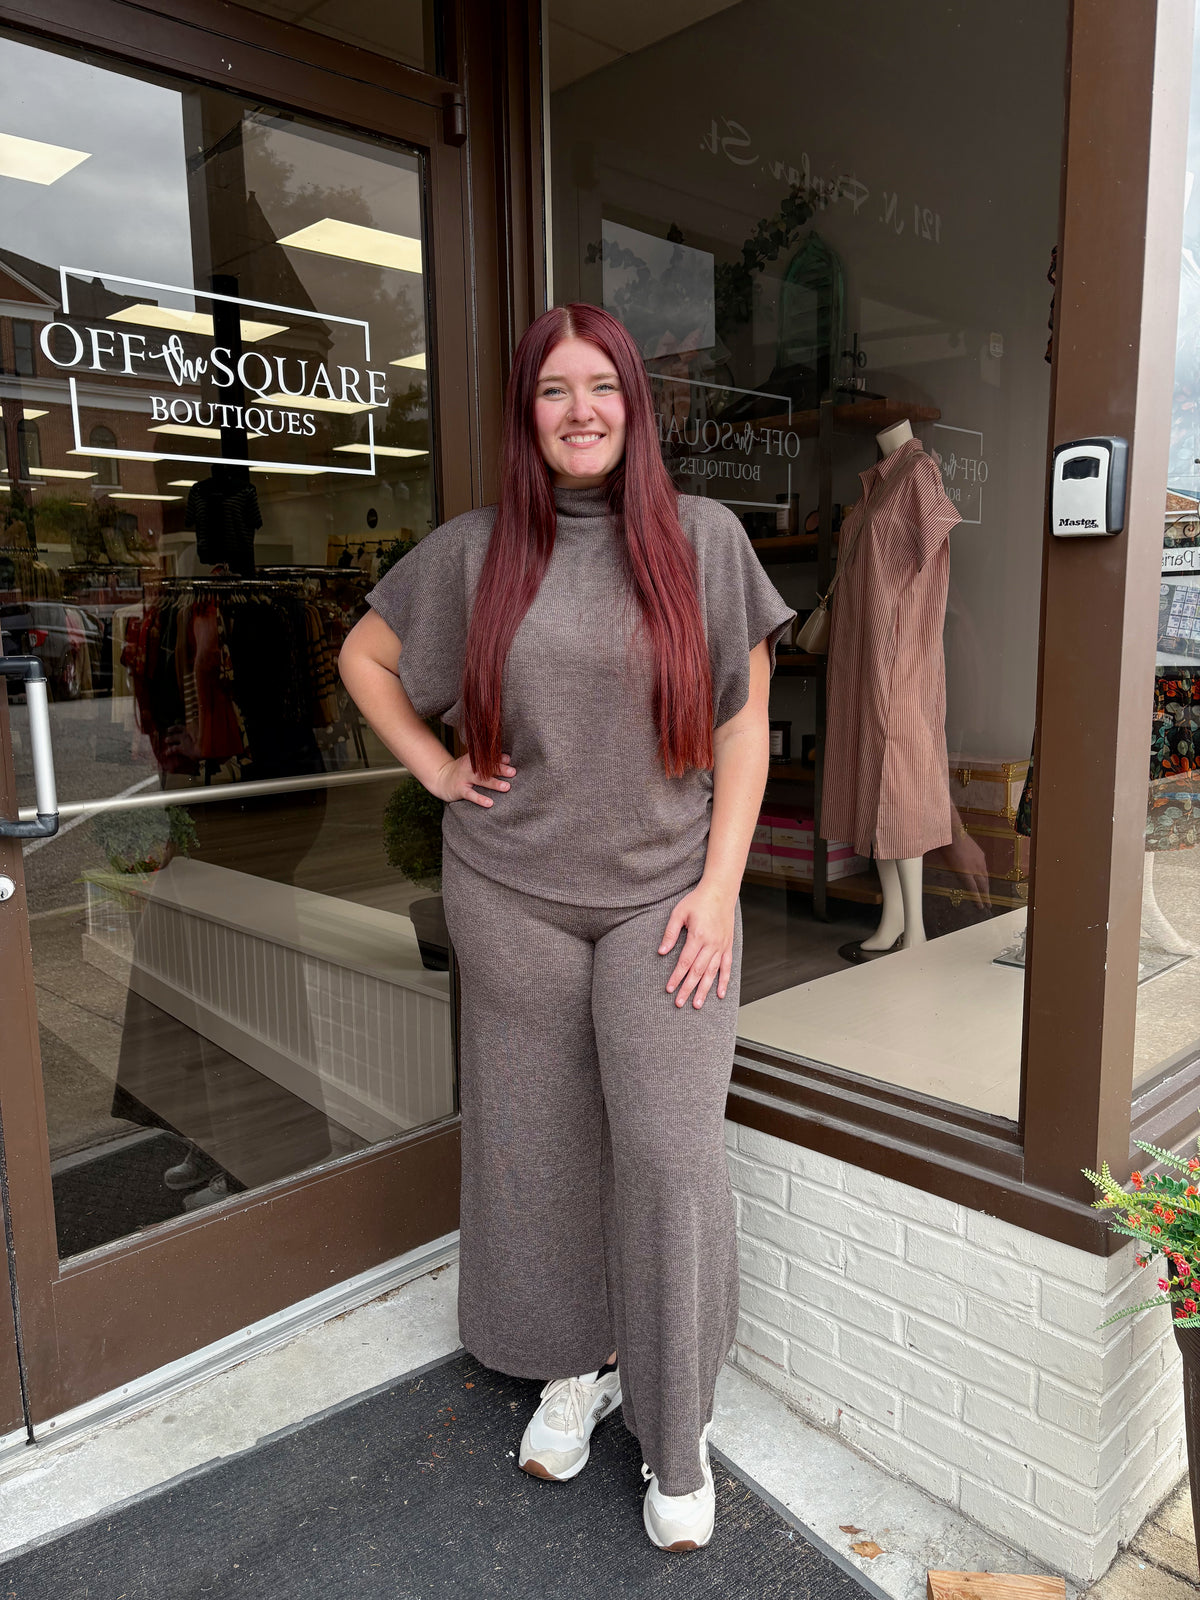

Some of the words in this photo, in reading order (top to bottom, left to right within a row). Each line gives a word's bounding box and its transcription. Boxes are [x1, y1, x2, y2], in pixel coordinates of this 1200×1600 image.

[39, 322, 146, 375] OFF
[149, 334, 208, 387] the
[210, 347, 391, 408] SQUARE
[149, 396, 316, 437] BOUTIQUES
[1058, 518, 1097, 527] Master
